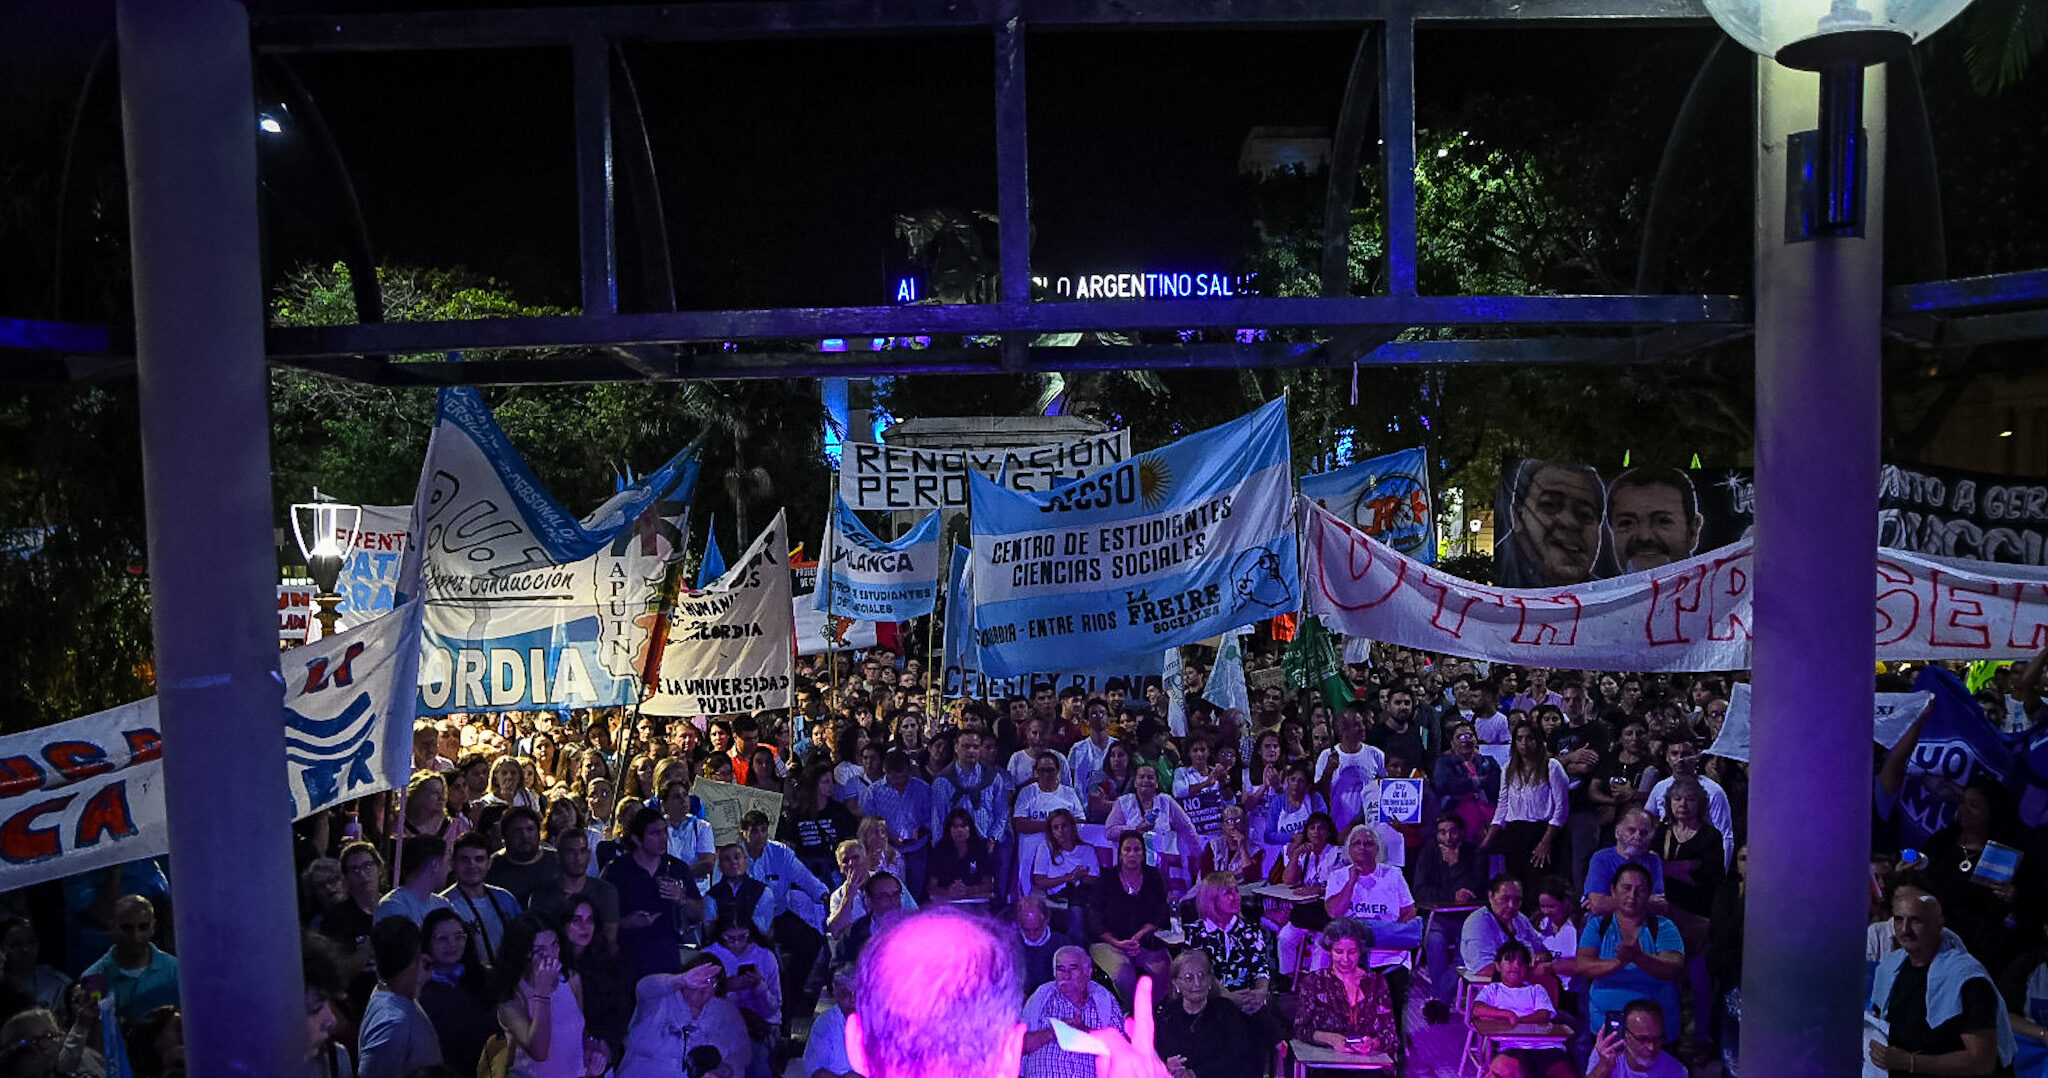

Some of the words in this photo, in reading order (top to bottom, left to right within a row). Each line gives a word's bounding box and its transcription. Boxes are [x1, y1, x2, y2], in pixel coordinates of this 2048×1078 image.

[1077, 273, 1192, 299] ARGENTINO
[857, 433, 1122, 475] RENOVACIÓN
[1984, 484, 2048, 520] GER
[992, 535, 1055, 564] CENTRO
[1064, 532, 1089, 556] DE
[1100, 496, 1232, 553] ESTUDIANTES
[1012, 558, 1101, 587] CIENCIAS
[1112, 532, 1207, 580] SOCIALES
[1126, 588, 1149, 604] LA
[1127, 584, 1221, 626] FREIRE
[1028, 615, 1075, 639] ENTRE
[1081, 610, 1118, 633] RIOS
[1153, 605, 1220, 634] SOCIALES
[414, 648, 599, 709] ORDIA
[666, 678, 684, 695] LA
[684, 675, 789, 696] UNIVERSIDAD
[1182, 797, 1201, 813] NO
